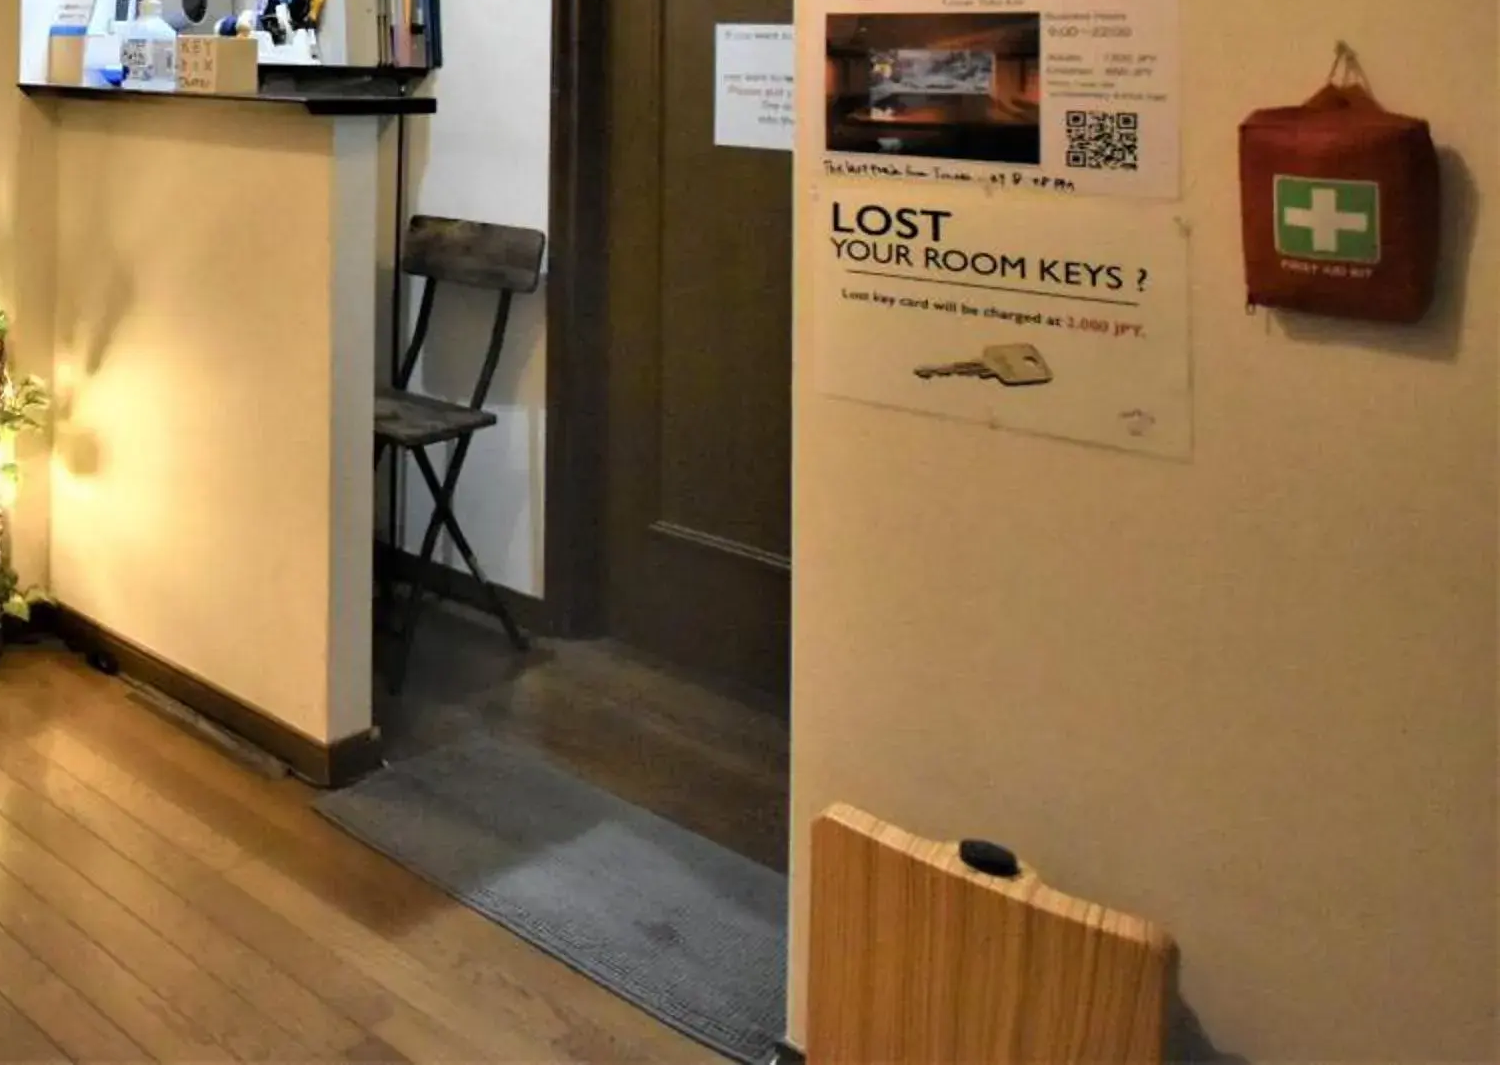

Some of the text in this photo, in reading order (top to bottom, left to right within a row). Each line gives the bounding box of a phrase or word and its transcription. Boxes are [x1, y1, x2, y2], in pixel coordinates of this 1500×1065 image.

[831, 201, 953, 242] LOST
[830, 236, 1149, 293] YOUR ROOM KEYS ?
[841, 288, 870, 302] Lost
[872, 293, 896, 309] key
[899, 295, 929, 311] card
[933, 299, 957, 314] will
[961, 303, 979, 316] be
[983, 306, 1042, 326] charged
[1046, 314, 1062, 328] at
